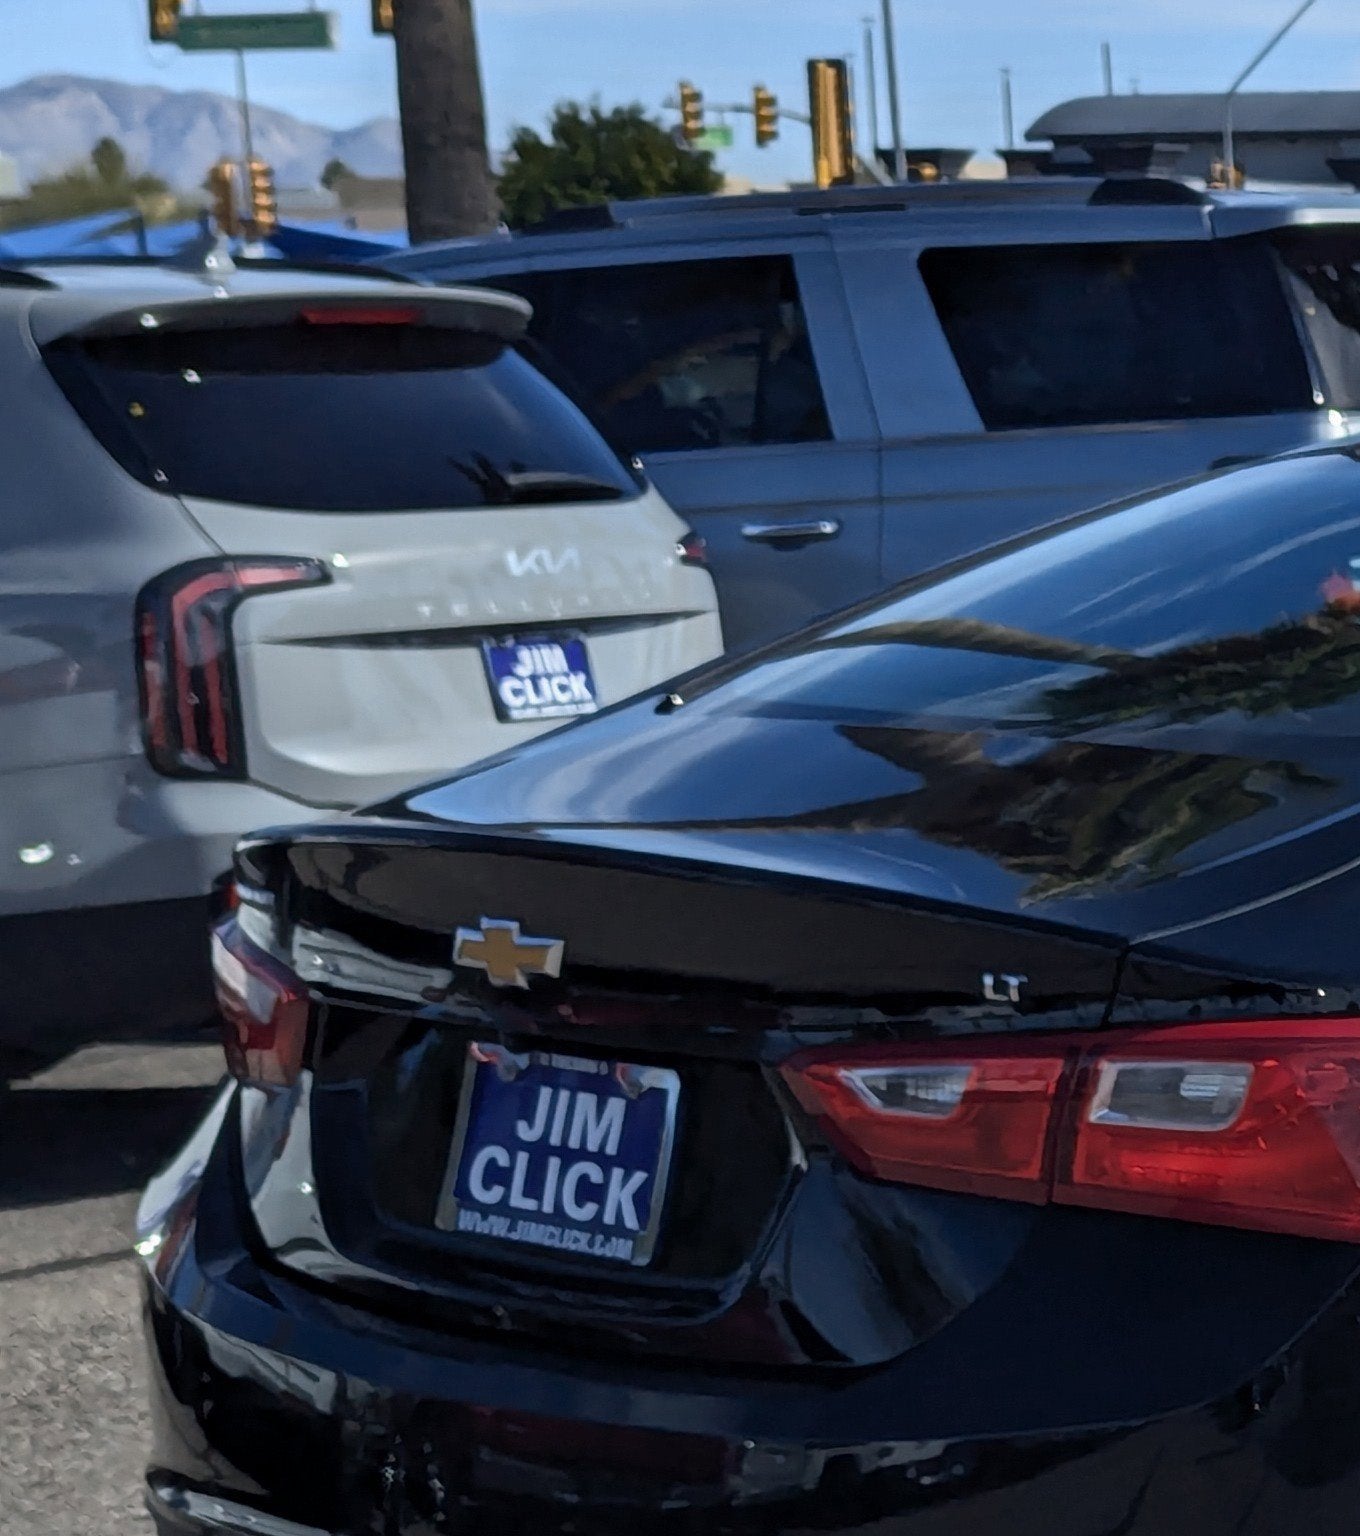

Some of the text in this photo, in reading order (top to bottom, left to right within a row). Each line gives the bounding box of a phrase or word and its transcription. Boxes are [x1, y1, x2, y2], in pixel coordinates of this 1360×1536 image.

[510, 643, 569, 677] JIM
[500, 670, 593, 707] CLICK
[982, 972, 1029, 1003] LT
[516, 1085, 627, 1156] JIM
[468, 1145, 649, 1231] CLICK
